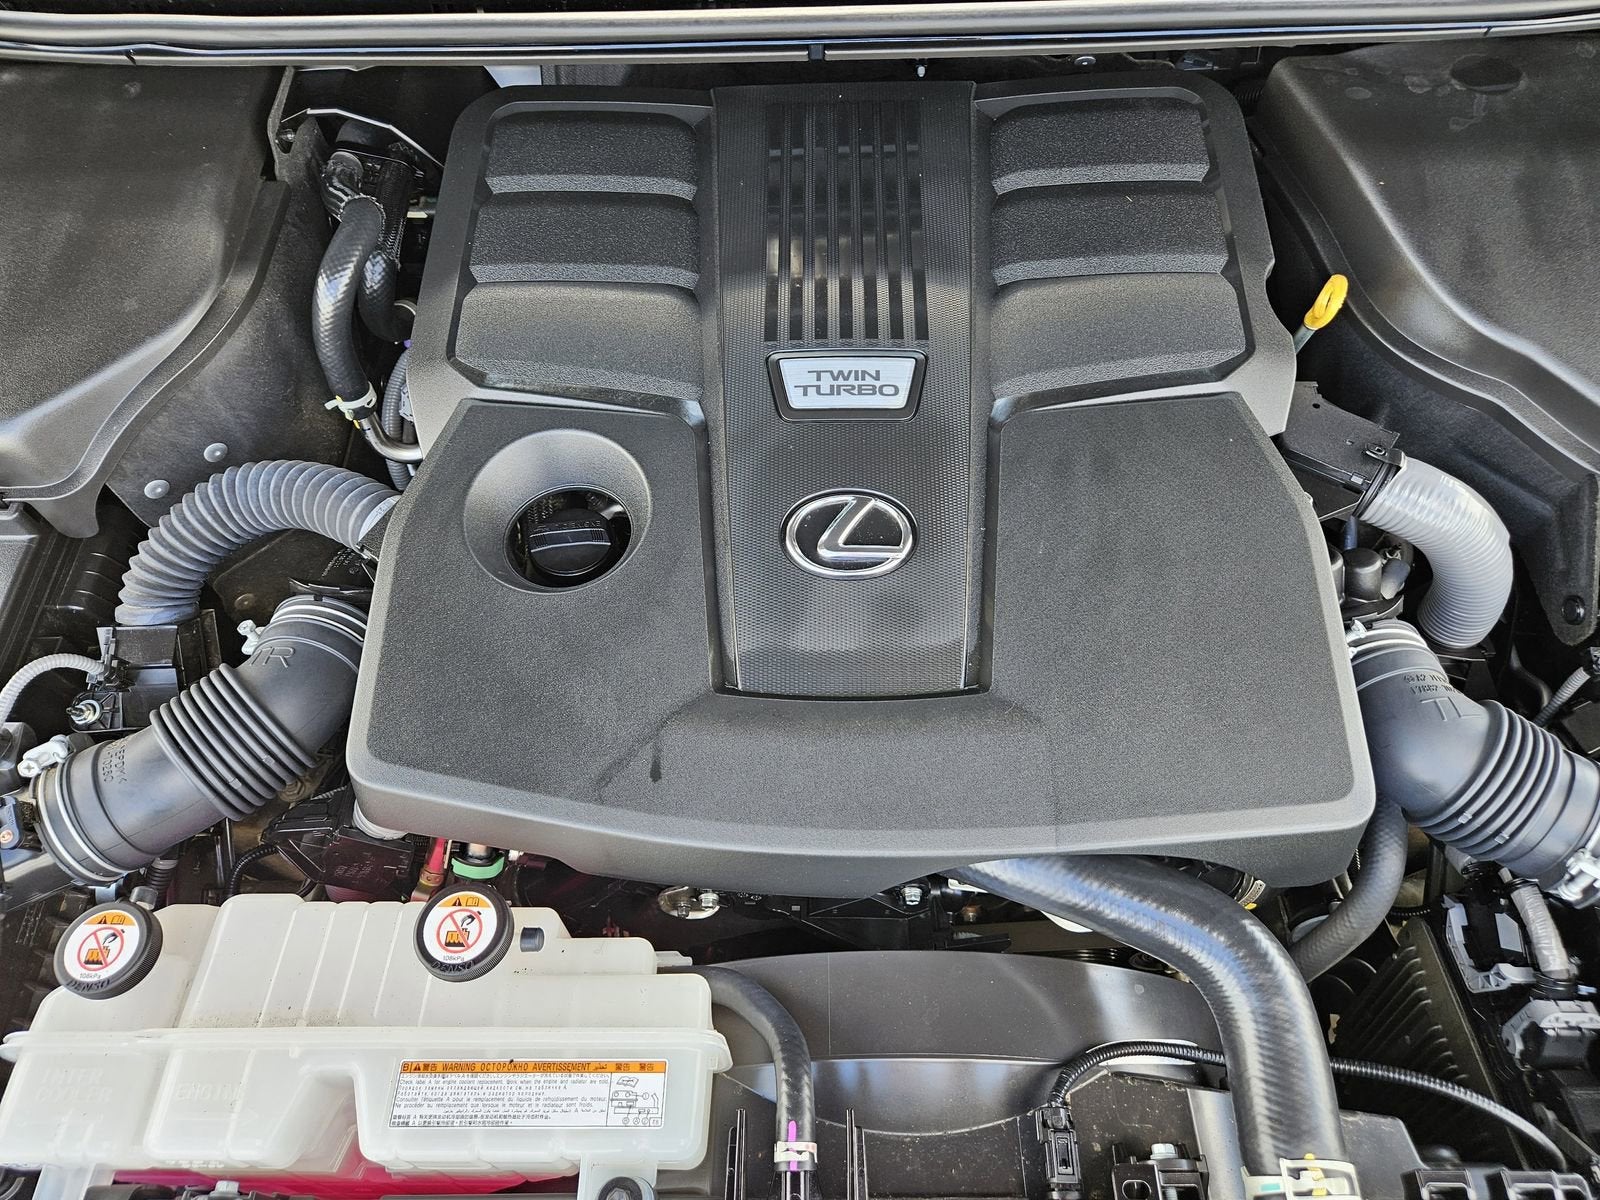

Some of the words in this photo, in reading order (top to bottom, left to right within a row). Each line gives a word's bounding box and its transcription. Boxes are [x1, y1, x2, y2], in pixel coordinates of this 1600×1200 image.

[807, 370, 881, 382] TWIN
[794, 384, 900, 397] TURBO
[66, 980, 110, 993] DENSO
[442, 1062, 476, 1071] WARNING
[532, 1062, 591, 1072] AVERTISSEMENT
